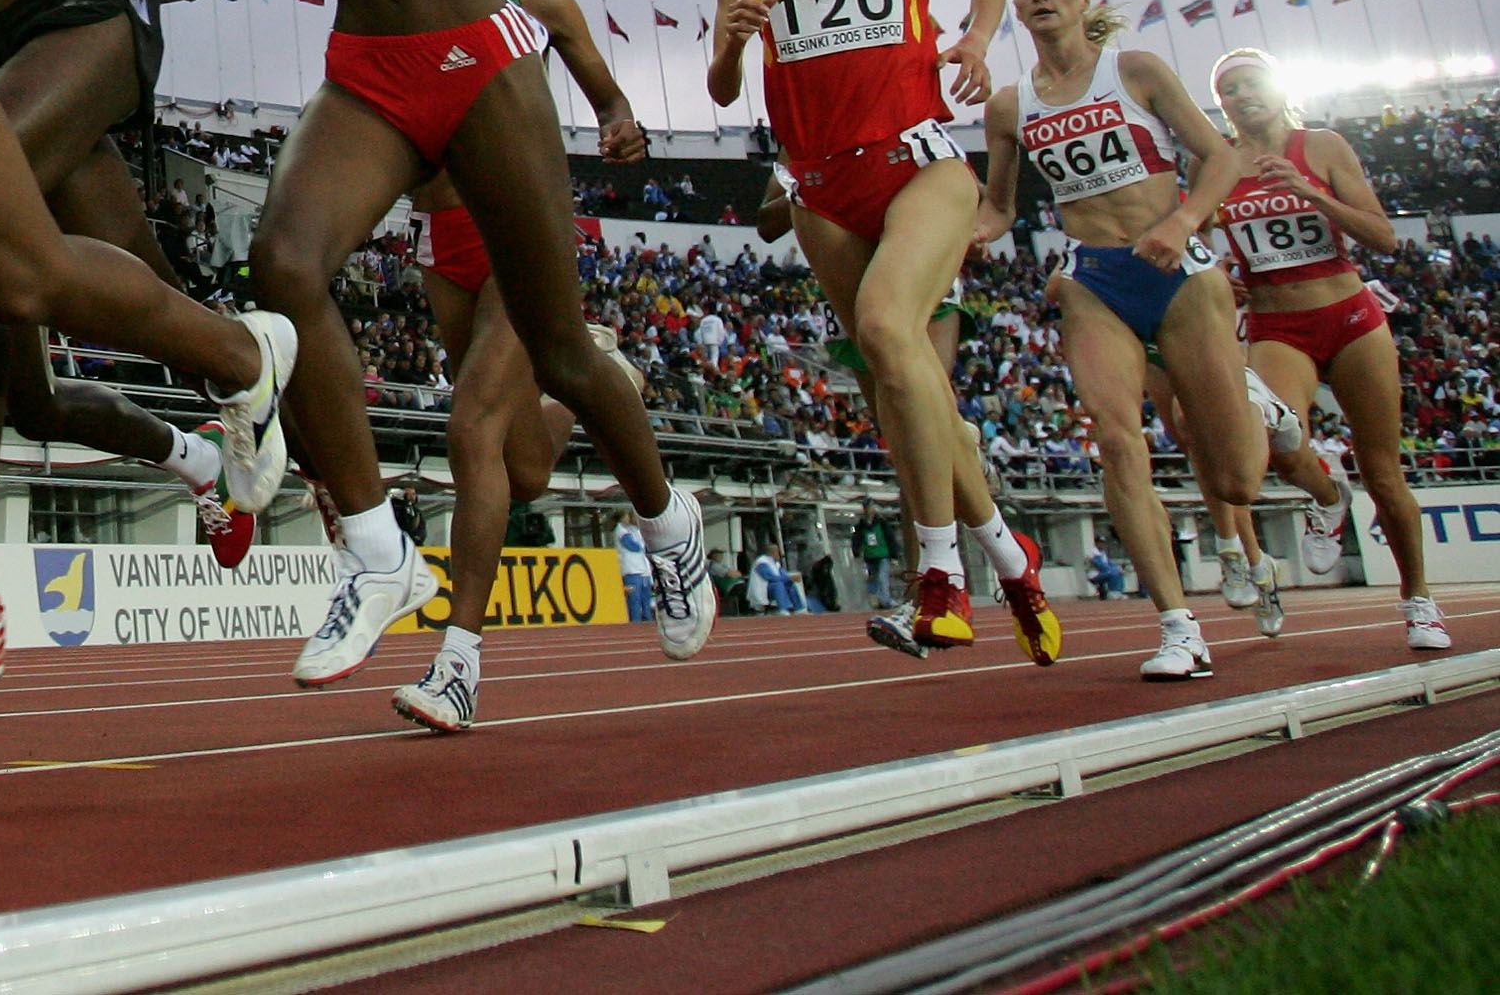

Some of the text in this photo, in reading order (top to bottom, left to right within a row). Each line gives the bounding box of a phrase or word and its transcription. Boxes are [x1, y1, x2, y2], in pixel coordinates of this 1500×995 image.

[780, 35, 830, 56] HELSINKI
[833, 30, 861, 46] 2005
[1026, 108, 1122, 145] TOYOTA
[1037, 130, 1129, 182] 664
[1086, 175, 1107, 190] 2005
[1109, 164, 1144, 183] ESPOO
[1241, 215, 1324, 254] 185
[109, 554, 224, 588] VANTAAN
[115, 604, 303, 644] CITY OF VANTAA
